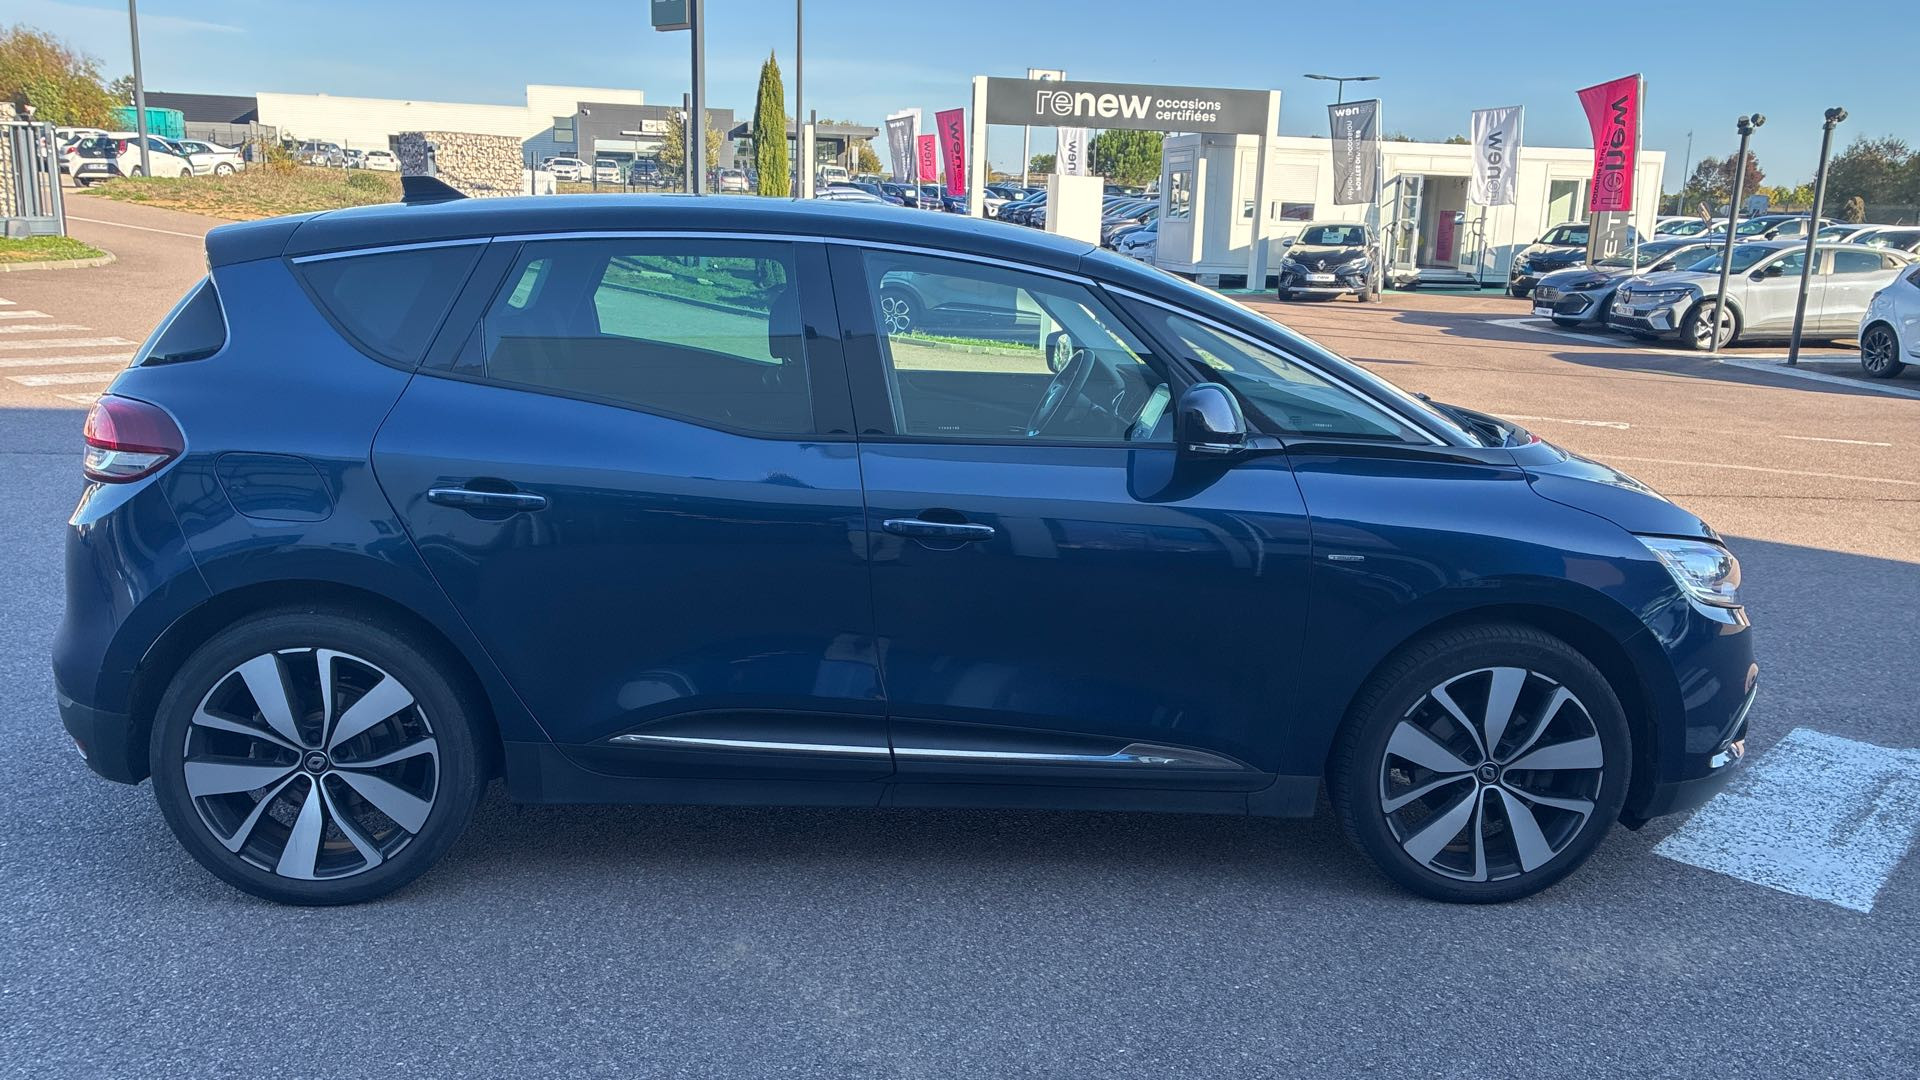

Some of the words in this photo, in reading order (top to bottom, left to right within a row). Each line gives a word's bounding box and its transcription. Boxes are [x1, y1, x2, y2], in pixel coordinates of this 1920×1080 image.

[1036, 90, 1152, 119] renew
[1156, 98, 1221, 111] occasions
[1156, 110, 1216, 122] certifiées
